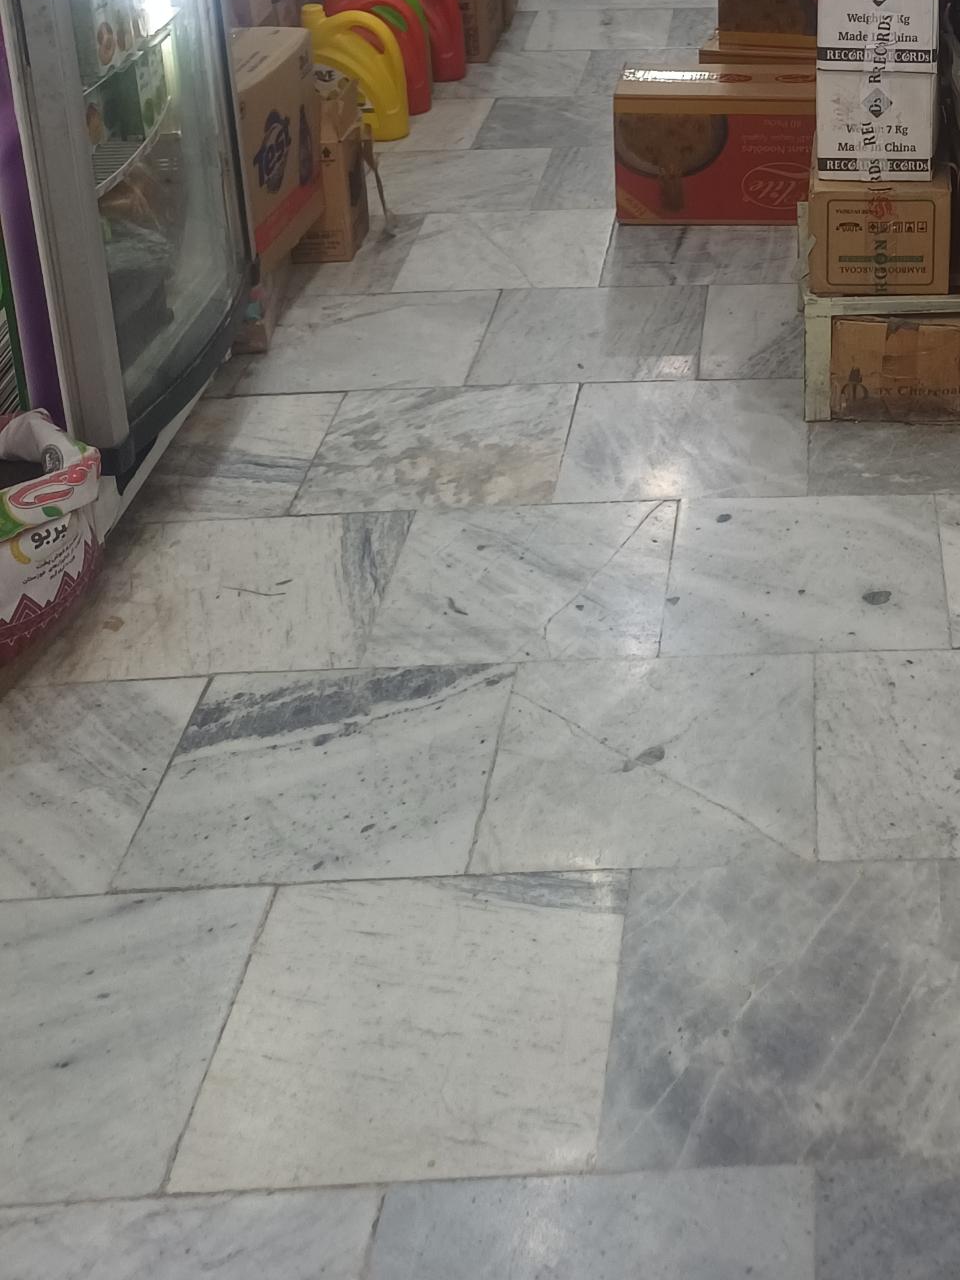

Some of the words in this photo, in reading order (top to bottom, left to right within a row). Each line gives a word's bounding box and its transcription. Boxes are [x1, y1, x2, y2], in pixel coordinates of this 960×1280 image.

[838, 31, 869, 41] Made
[895, 125, 909, 136] Kg
[884, 141, 917, 153] China
